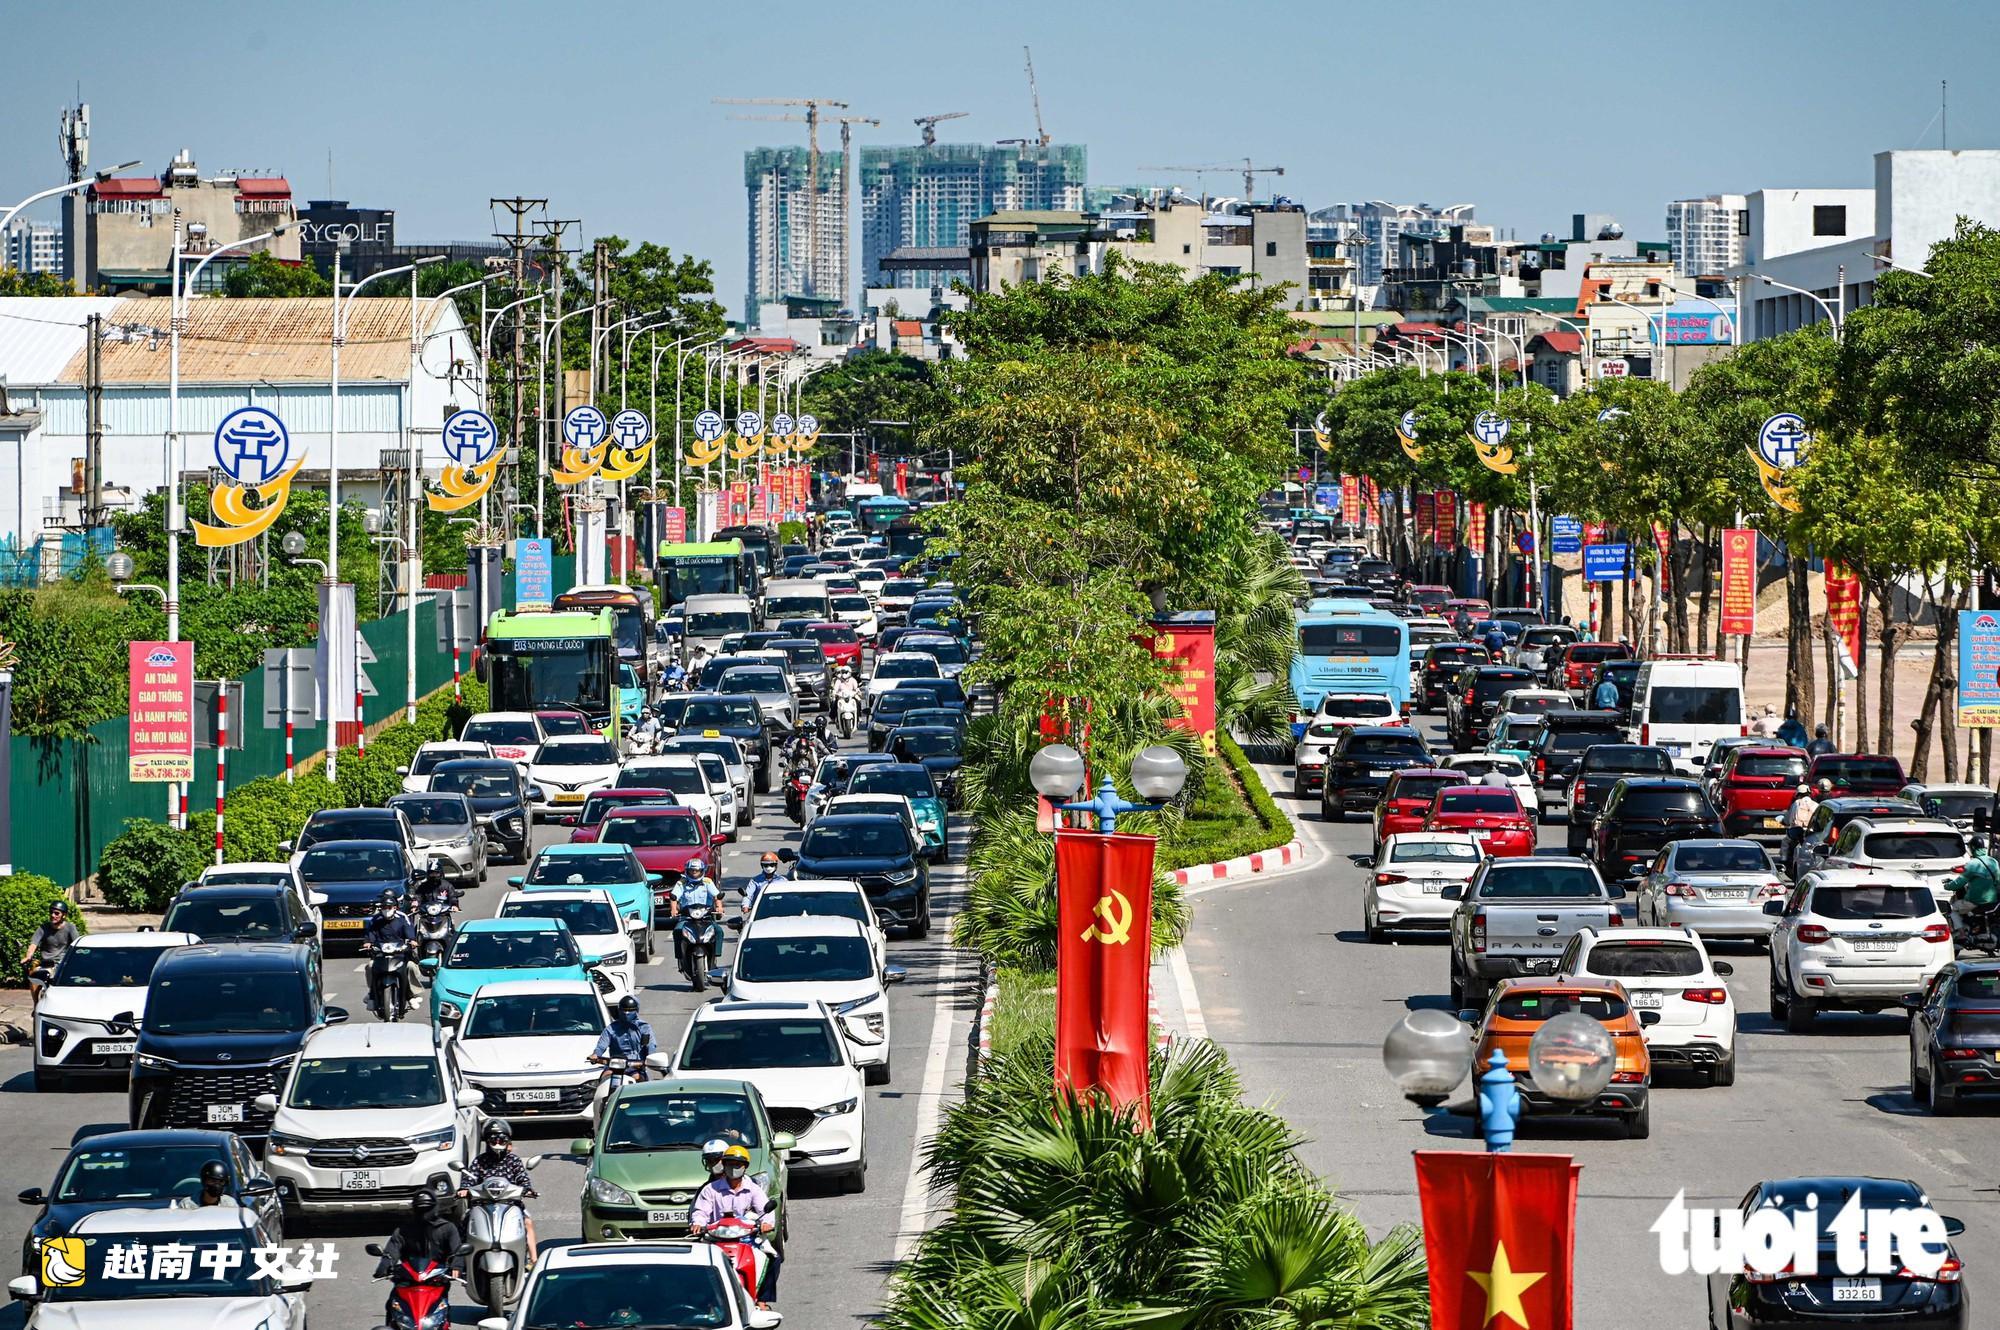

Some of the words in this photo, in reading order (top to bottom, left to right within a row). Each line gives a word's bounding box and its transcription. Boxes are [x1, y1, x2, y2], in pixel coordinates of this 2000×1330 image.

[514, 642, 527, 651] E03
[144, 672, 157, 684] AN
[157, 670, 178, 684] TOÀN
[139, 691, 157, 703] GIAO
[158, 689, 183, 703] THÔNG
[133, 708, 144, 723] LÀ
[145, 711, 166, 725] HẠNH
[167, 708, 188, 723] PHÚC
[134, 728, 150, 743] CỦA
[151, 731, 167, 746] MỌI
[168, 729, 187, 743] NHÀ!
[177, 758, 189, 766] BIÊN
[217, 1105, 233, 1114] 30M
[211, 1113, 240, 1122] 914.35
[352, 1171, 370, 1180] 30H
[346, 1180, 377, 1190] 456.30
[1847, 1277, 1867, 1288] 17A
[1838, 1289, 1876, 1300] 332.60
